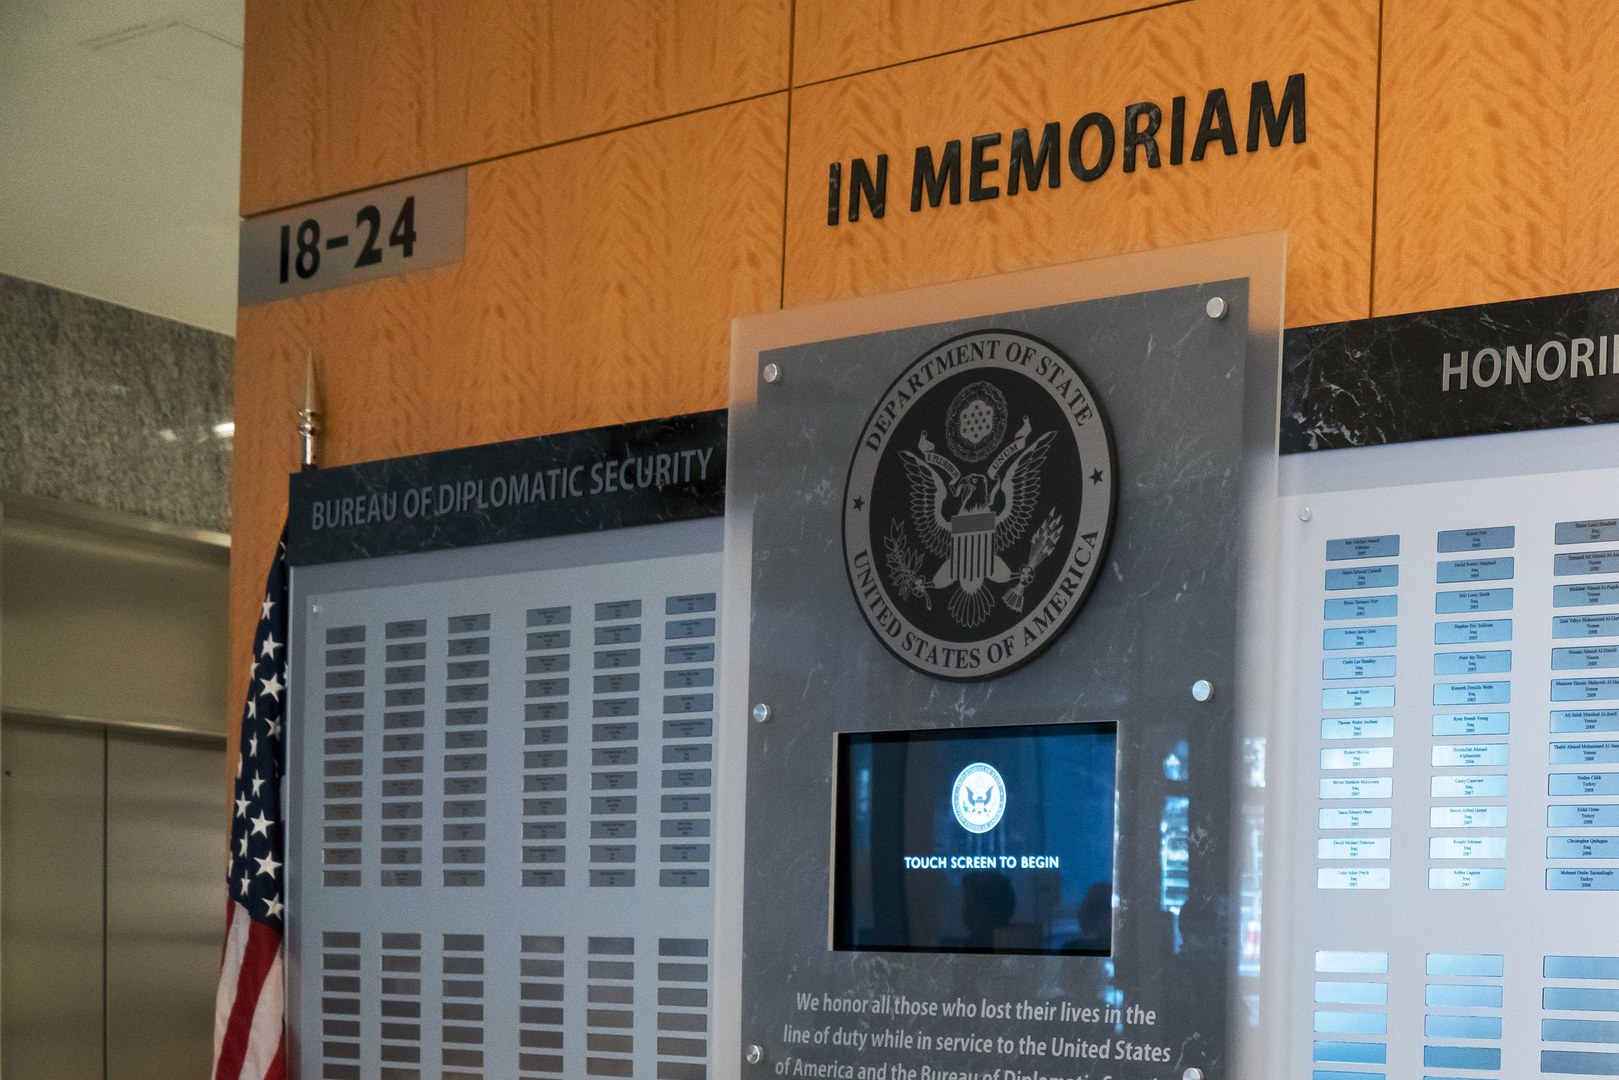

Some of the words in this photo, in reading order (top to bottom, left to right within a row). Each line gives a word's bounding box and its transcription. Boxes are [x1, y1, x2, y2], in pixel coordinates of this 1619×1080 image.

[827, 153, 888, 226] IN
[910, 73, 1306, 212] MEMORIAM
[279, 196, 417, 283] 18-24
[865, 340, 1000, 453] DEPARTMENT
[1005, 341, 1035, 369] OF
[1036, 357, 1094, 427] STATE
[992, 444, 1018, 469] UNUM
[311, 488, 397, 531] BUREAU
[402, 484, 433, 519] OF
[433, 464, 585, 514] DIPLOMATIC
[590, 447, 714, 496] SECURITY
[854, 551, 900, 640] UNITED
[902, 632, 981, 669] STATES
[987, 637, 1015, 665] OF
[1024, 529, 1099, 647] AMERICA
[904, 856, 947, 870] TOUCH
[950, 855, 997, 870] SCREEN
[999, 856, 1017, 870] TO
[1021, 855, 1059, 869] BEGIN
[797, 993, 819, 1012] We
[823, 994, 868, 1014] honor
[871, 996, 891, 1014] all
[894, 996, 937, 1017] those
[942, 998, 977, 1019] who
[981, 999, 1011, 1019] lost
[1016, 1001, 1057, 1022] their
[1060, 1001, 1099, 1023] lives
[1104, 1004, 1120, 1024] in
[1126, 1005, 1156, 1025] the
[775, 1058, 790, 1076] of
[792, 1058, 853, 1080] America
[858, 1061, 885, 1080] and
[783, 1025, 810, 1044] line
[813, 1026, 829, 1045] of
[833, 1027, 868, 1050] duty
[871, 1029, 913, 1049] while
[917, 1031, 932, 1050] in
[936, 1032, 993, 1054] service
[997, 1034, 1014, 1055] to
[1018, 1035, 1046, 1056] the
[1051, 1037, 1109, 1059] United
[1114, 1040, 1171, 1062] States
